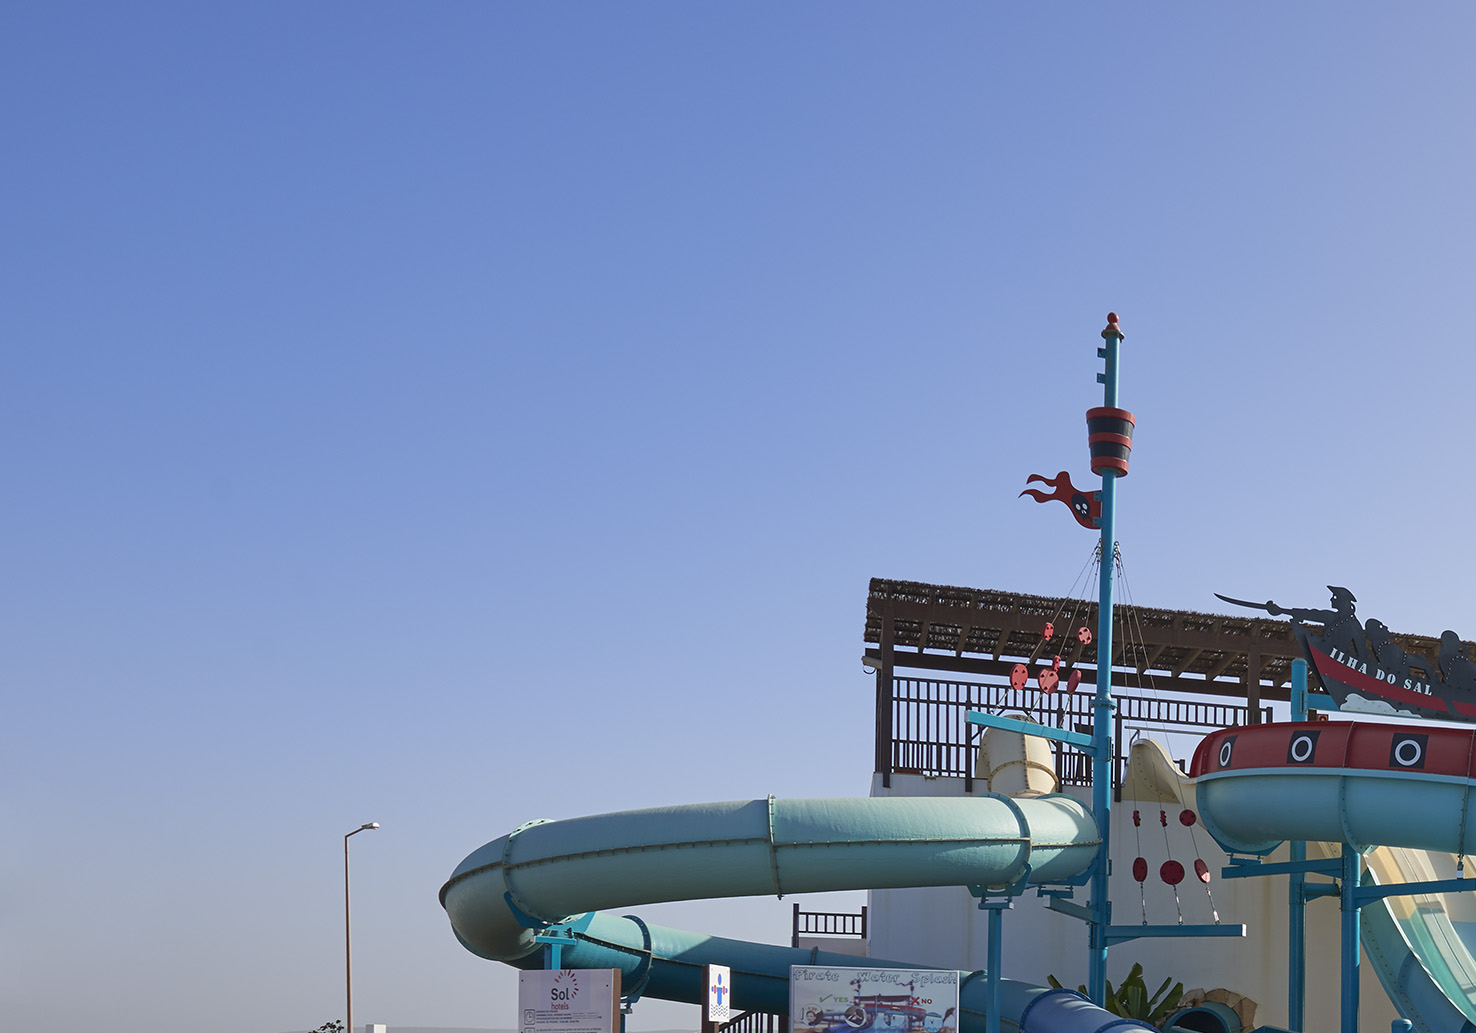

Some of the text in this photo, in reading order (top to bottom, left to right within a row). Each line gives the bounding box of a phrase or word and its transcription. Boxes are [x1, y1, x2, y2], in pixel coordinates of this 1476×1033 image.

[1329, 647, 1433, 696] ILHA DO SAL
[794, 969, 958, 987] Pirate Water Splash
[551, 987, 570, 1001] Sol
[550, 1001, 569, 1010] hotels
